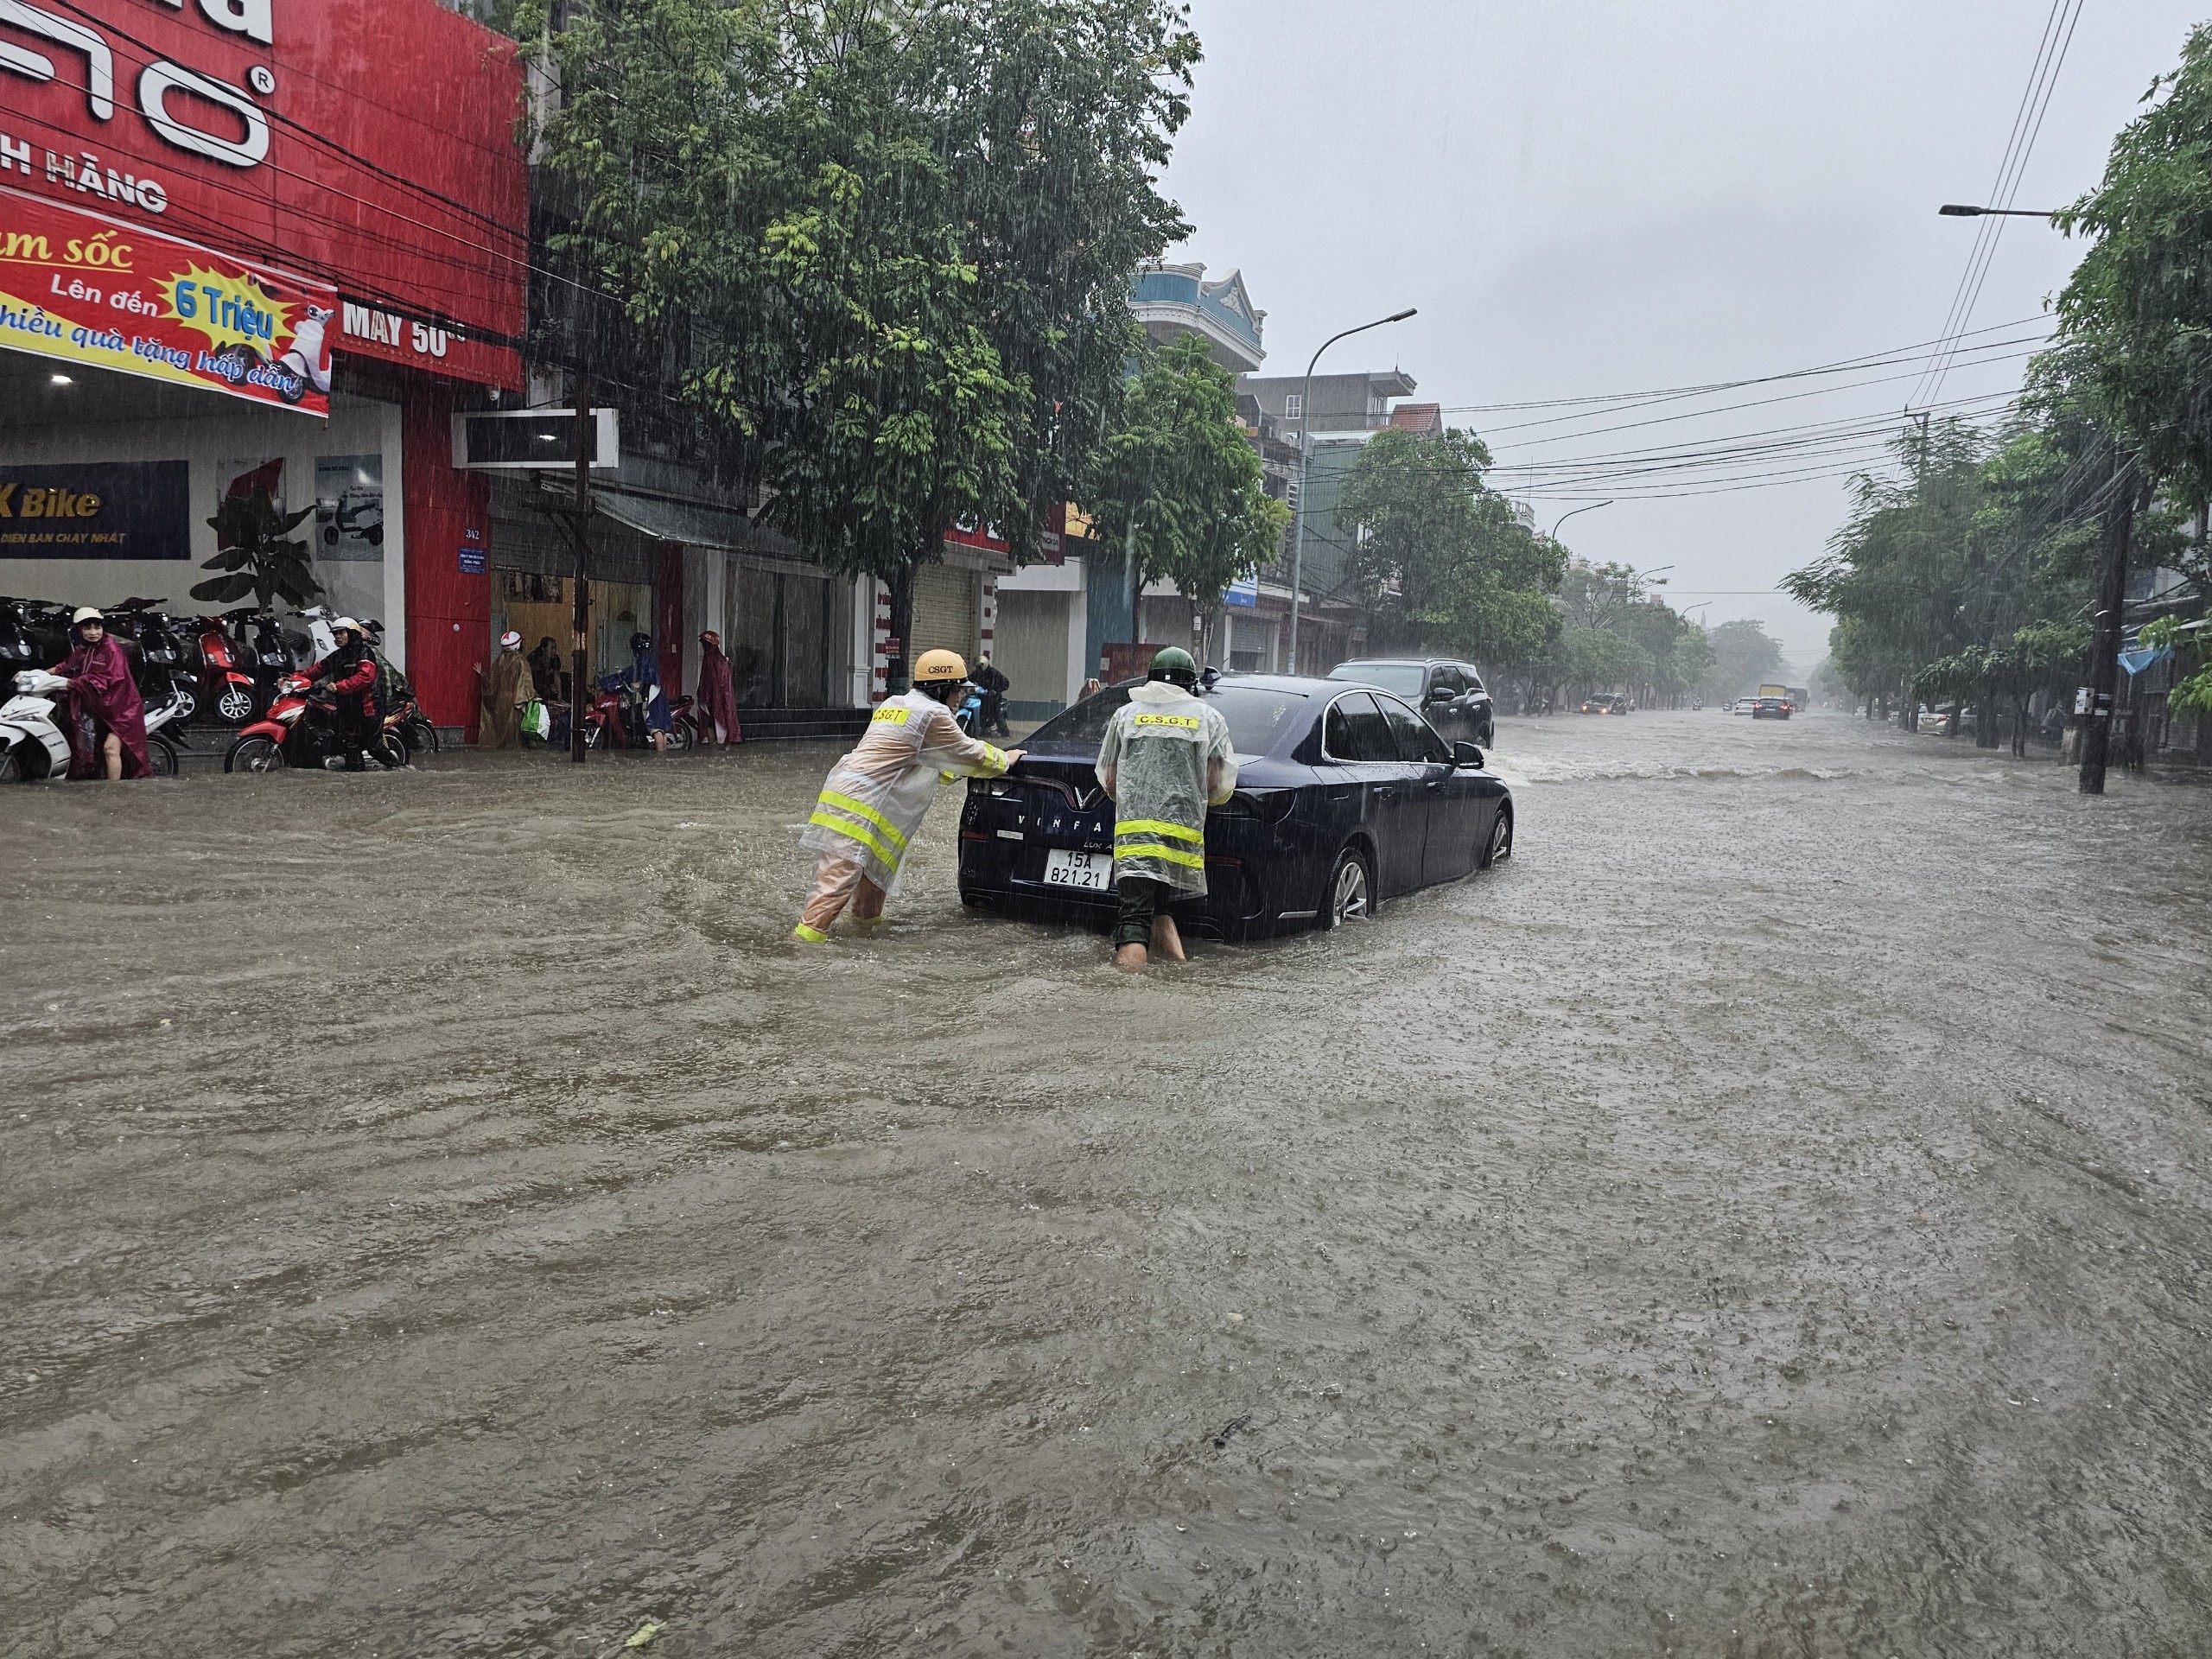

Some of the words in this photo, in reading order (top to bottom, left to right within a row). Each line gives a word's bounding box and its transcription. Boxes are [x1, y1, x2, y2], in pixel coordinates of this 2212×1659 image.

[0, 232, 53, 260] m
[63, 229, 133, 268] sốc
[50, 273, 102, 304] Lên
[110, 290, 158, 317] đến
[175, 280, 197, 318] 6
[202, 285, 273, 340] Triệu
[71, 327, 125, 352] quà
[132, 336, 191, 371] tặng
[198, 350, 244, 382] hấp
[248, 363, 294, 391] dẫn
[20, 486, 100, 518] Bike
[466, 529, 480, 540] 342
[928, 665, 954, 674] CSGT
[1140, 715, 1192, 726] C.S.G.T
[1067, 851, 1091, 869] 15A
[1051, 867, 1100, 887] 821.21
